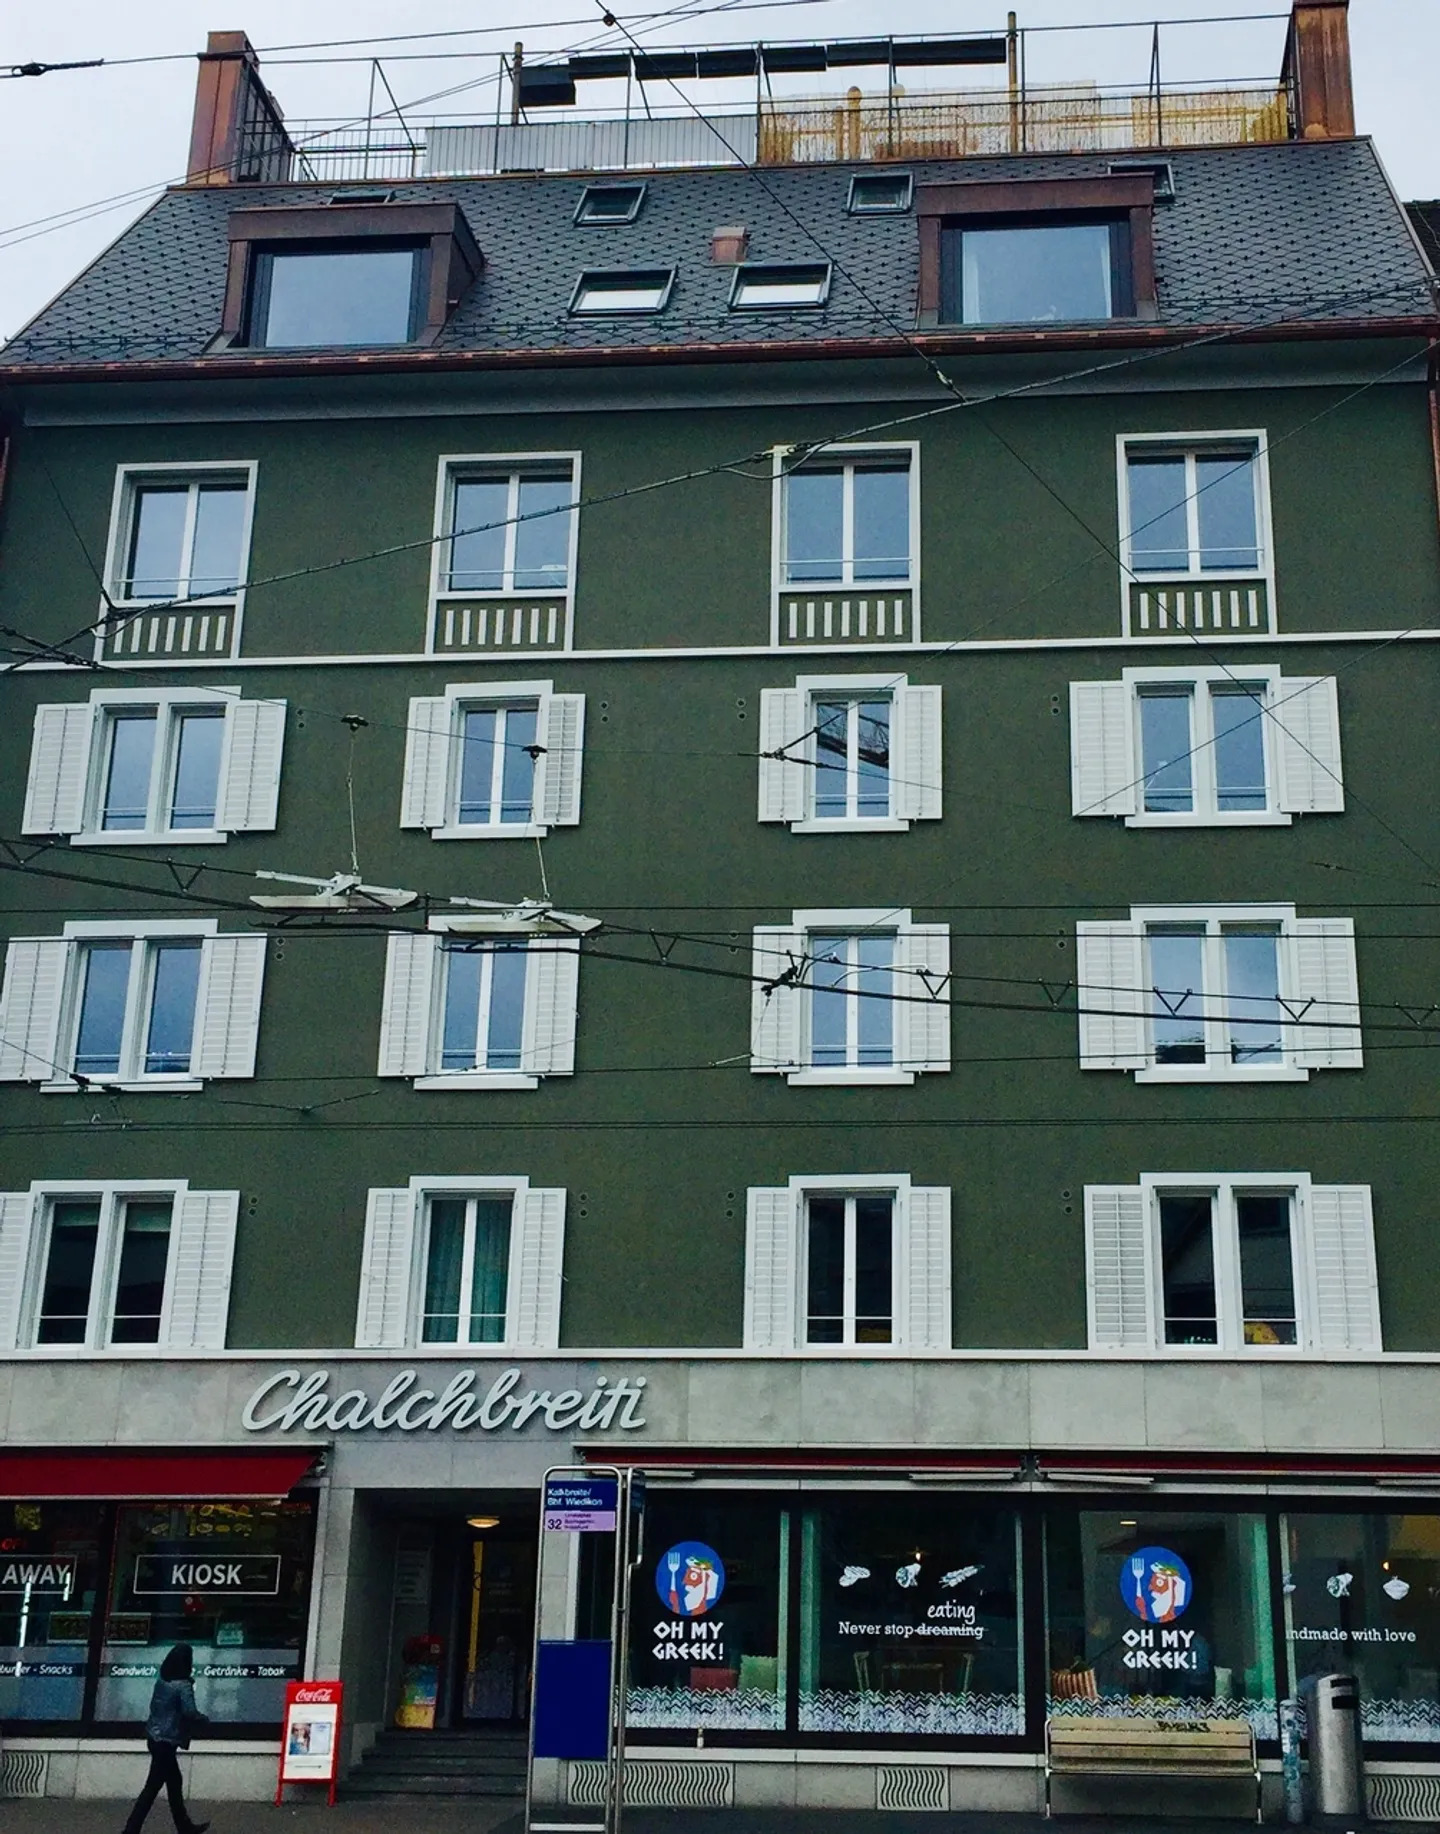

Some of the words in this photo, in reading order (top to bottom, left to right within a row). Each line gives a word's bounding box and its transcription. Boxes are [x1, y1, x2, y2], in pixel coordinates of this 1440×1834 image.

[242, 1367, 647, 1432] Chalchbreiti
[548, 1518, 563, 1530] 32
[2, 1564, 70, 1585] AWAY
[171, 1564, 243, 1585] KIOSK
[927, 1599, 976, 1625] eating
[653, 1621, 684, 1640] OH
[690, 1621, 724, 1640] MY
[838, 1621, 882, 1635] Never
[884, 1622, 914, 1638] stop
[917, 1622, 984, 1640] dreaming
[1122, 1628, 1154, 1648] OH
[1162, 1629, 1195, 1648] MY
[1351, 1628, 1382, 1641] with
[1384, 1628, 1416, 1642] love
[652, 1642, 724, 1661] GREEK!
[1122, 1650, 1198, 1670] GREEK!
[39, 1664, 73, 1675] Snacks
[110, 1665, 157, 1676] Sandwich
[258, 1666, 287, 1677] Tabak
